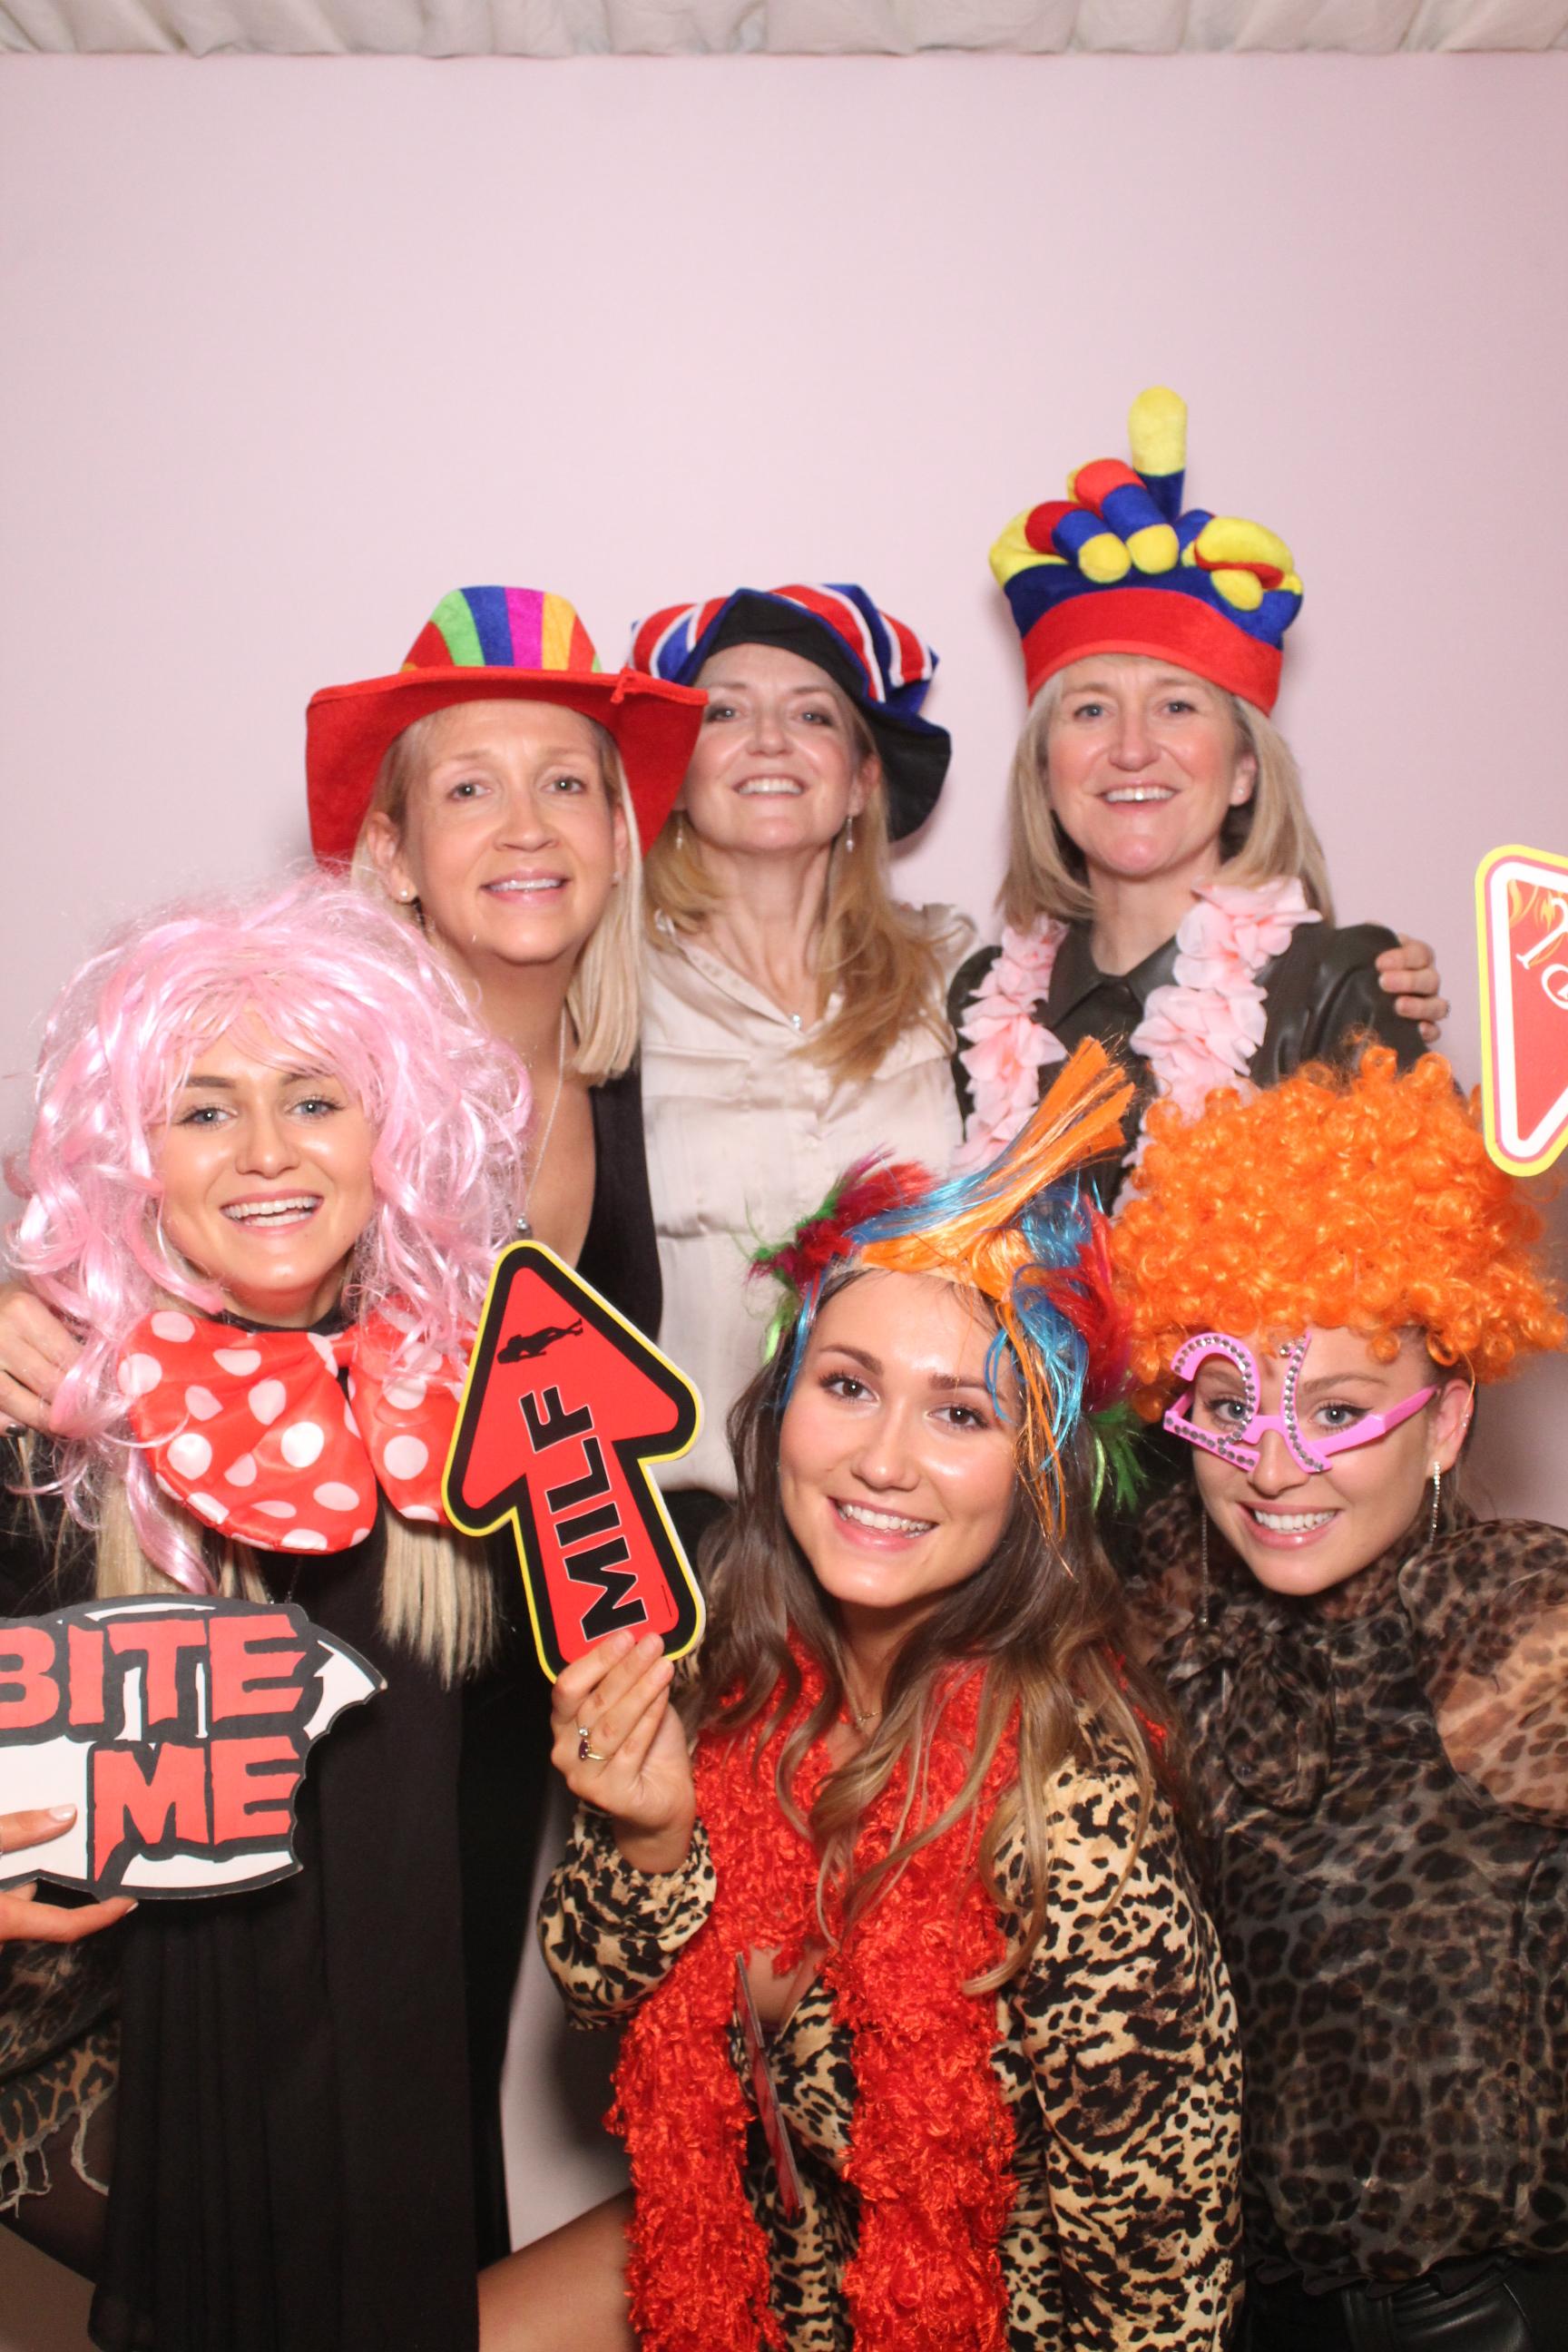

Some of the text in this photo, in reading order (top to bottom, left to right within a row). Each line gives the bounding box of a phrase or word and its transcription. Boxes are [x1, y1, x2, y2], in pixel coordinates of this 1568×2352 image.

[519, 1386, 648, 1642] MILF
[0, 1614, 307, 1729] BITE
[93, 1735, 301, 1882] ME
